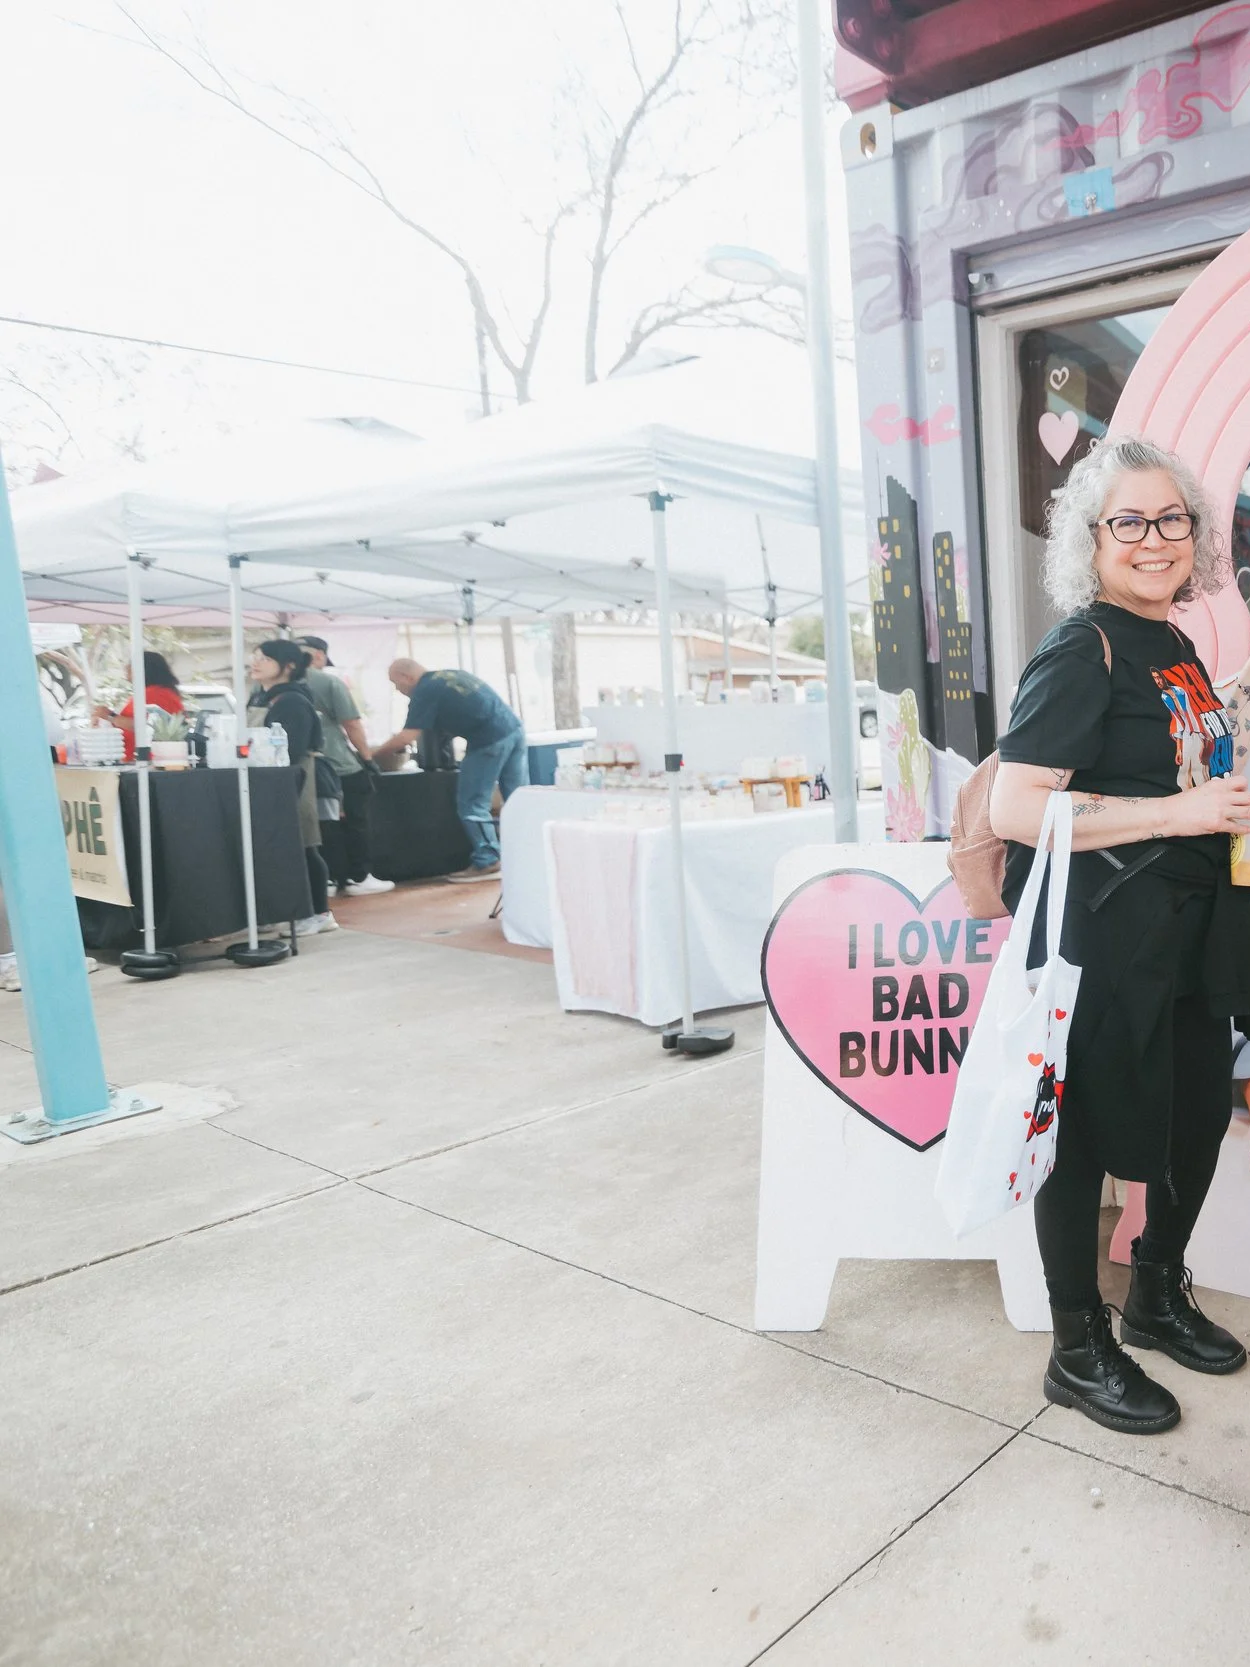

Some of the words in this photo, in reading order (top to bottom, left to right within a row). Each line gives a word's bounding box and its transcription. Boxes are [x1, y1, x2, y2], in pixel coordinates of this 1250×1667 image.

[848, 923, 858, 970] I
[873, 918, 993, 968] LOVE
[872, 972, 970, 1022] BAD
[839, 1025, 975, 1078] BUNN
